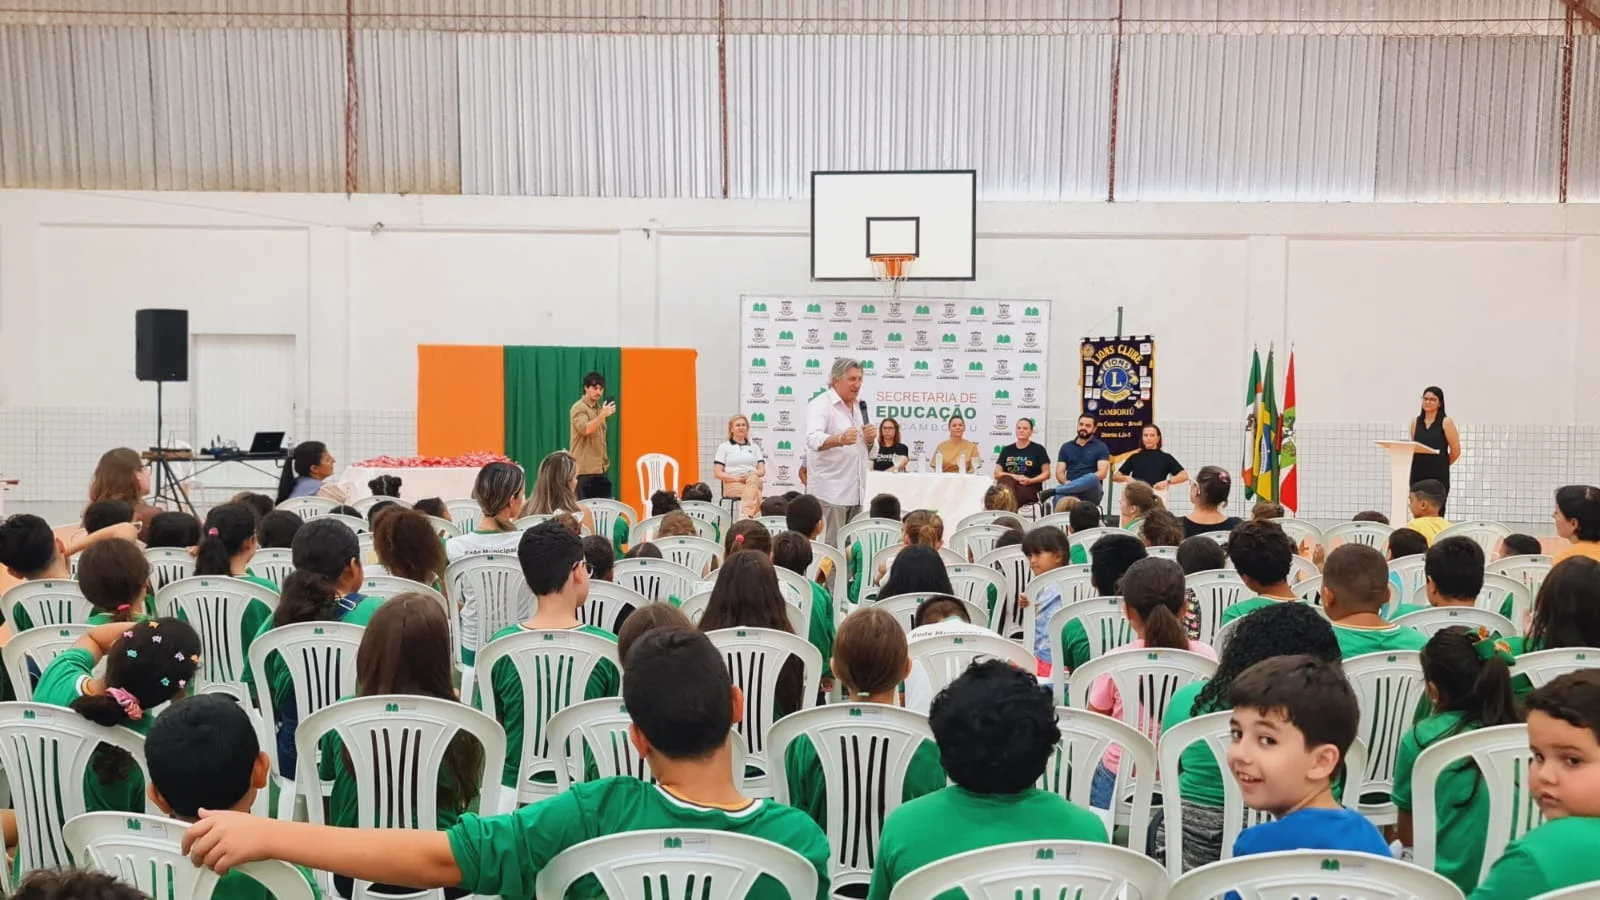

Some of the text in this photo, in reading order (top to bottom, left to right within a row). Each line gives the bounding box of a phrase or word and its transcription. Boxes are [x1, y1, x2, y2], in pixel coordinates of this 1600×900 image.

[1092, 344, 1144, 366] LIONS CLUBE
[1103, 359, 1130, 369] LIONS
[1111, 371, 1122, 387] L
[876, 391, 977, 403] SECRETARIA DE
[876, 404, 977, 422] EDUCAÇÃO
[1098, 406, 1135, 416] CAMBORIÚ
